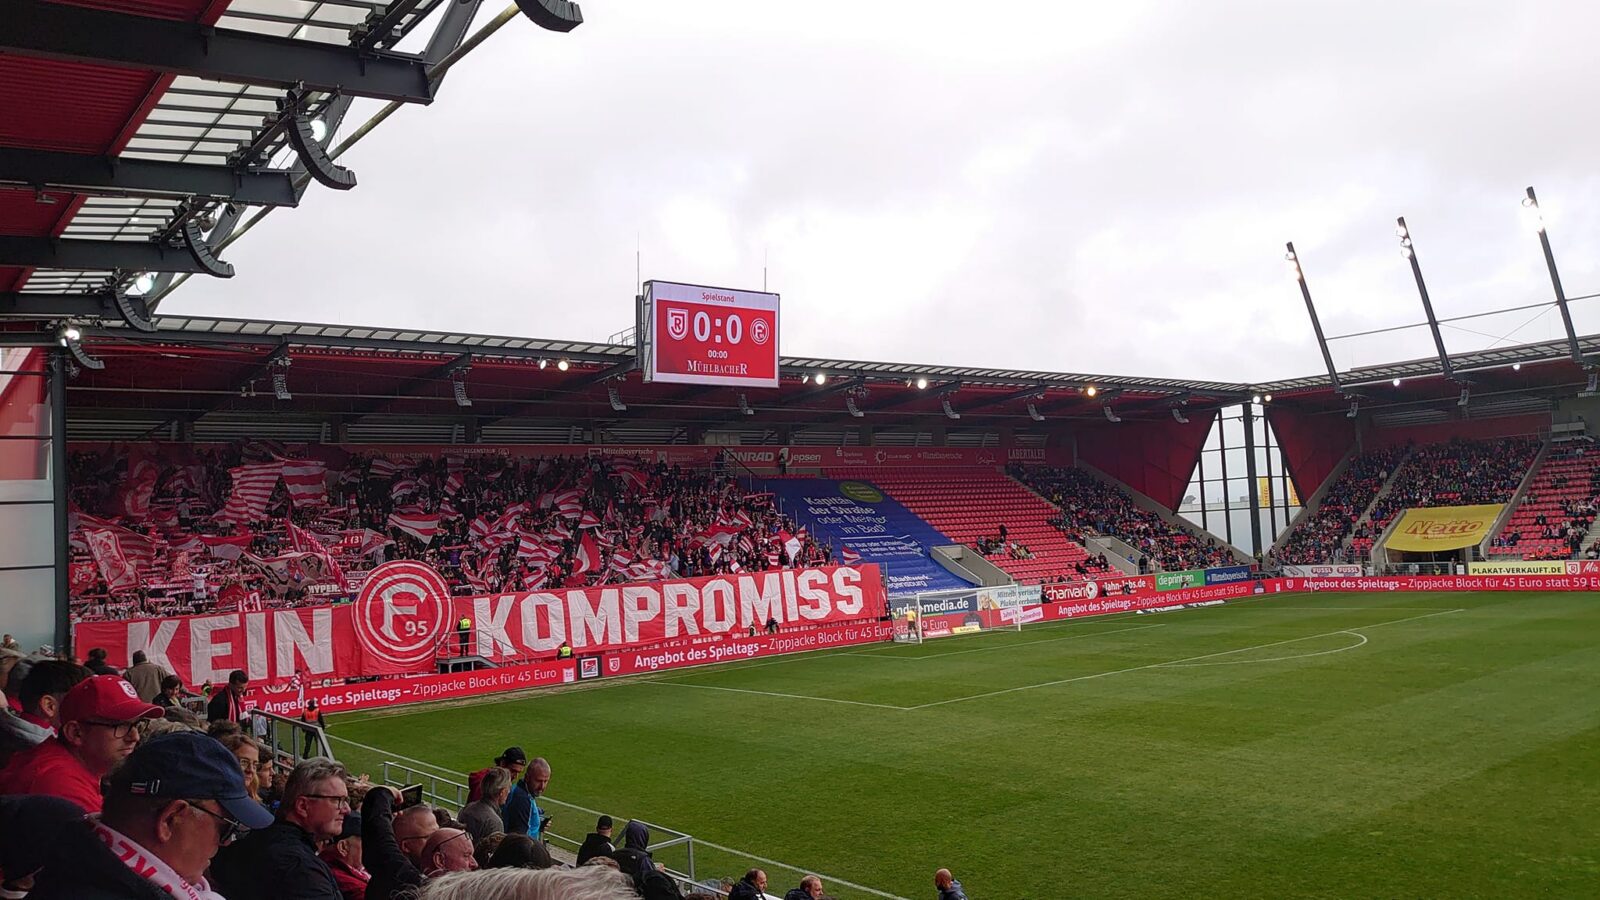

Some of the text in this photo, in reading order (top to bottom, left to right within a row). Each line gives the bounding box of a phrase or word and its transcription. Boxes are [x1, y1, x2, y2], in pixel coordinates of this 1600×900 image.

[702, 292, 735, 303] Spielstand
[693, 311, 743, 346] 0:0
[707, 350, 728, 360] 00:00
[687, 360, 748, 375] MÜHLBACHER
[808, 506, 831, 515] der
[1405, 520, 1484, 535] Netto
[1472, 566, 1562, 575] PLAKAT-VERKAUFT.DE
[1168, 573, 1195, 587] printen
[1303, 579, 1339, 590] Angebot
[1340, 579, 1356, 589] des
[1357, 579, 1400, 591] Spieltags
[1408, 578, 1454, 590] Zippjacke
[1456, 578, 1483, 588] Block
[1485, 577, 1500, 588] für
[1502, 578, 1516, 588] 45
[1519, 578, 1543, 588] Euro
[1545, 578, 1570, 588] statt
[1573, 577, 1587, 588] 59
[997, 588, 1040, 599] Mittelbyerische
[1058, 602, 1088, 617] Angebot
[1088, 600, 1101, 613] des
[1101, 597, 1132, 612] Spieltags
[1136, 592, 1166, 609] Zippjacke
[1166, 590, 1182, 604] Block
[1182, 590, 1192, 602] für
[1192, 589, 1201, 599] 45
[1200, 588, 1214, 599] Euro
[1213, 587, 1227, 596] statt
[1227, 585, 1235, 595] 59
[1235, 584, 1248, 594] Euro
[474, 566, 863, 660] KOMPROMISS
[405, 620, 428, 637] 95
[128, 607, 336, 687] KEIN
[635, 650, 686, 670] Angebot
[686, 646, 708, 661] des
[709, 640, 760, 660] Spieltags
[768, 634, 816, 653] Zippjacke
[818, 630, 844, 645] Block
[844, 627, 859, 641] für
[860, 626, 873, 638] 45
[874, 624, 894, 637] Euro
[929, 618, 949, 630] Euro
[264, 697, 319, 715] Angebot
[321, 693, 344, 708] des
[346, 686, 402, 705] Spieltags
[413, 679, 467, 697] Zippjacke
[469, 675, 499, 689] Block
[500, 672, 516, 685] für
[518, 671, 532, 682] 45
[534, 668, 558, 681] Euro
